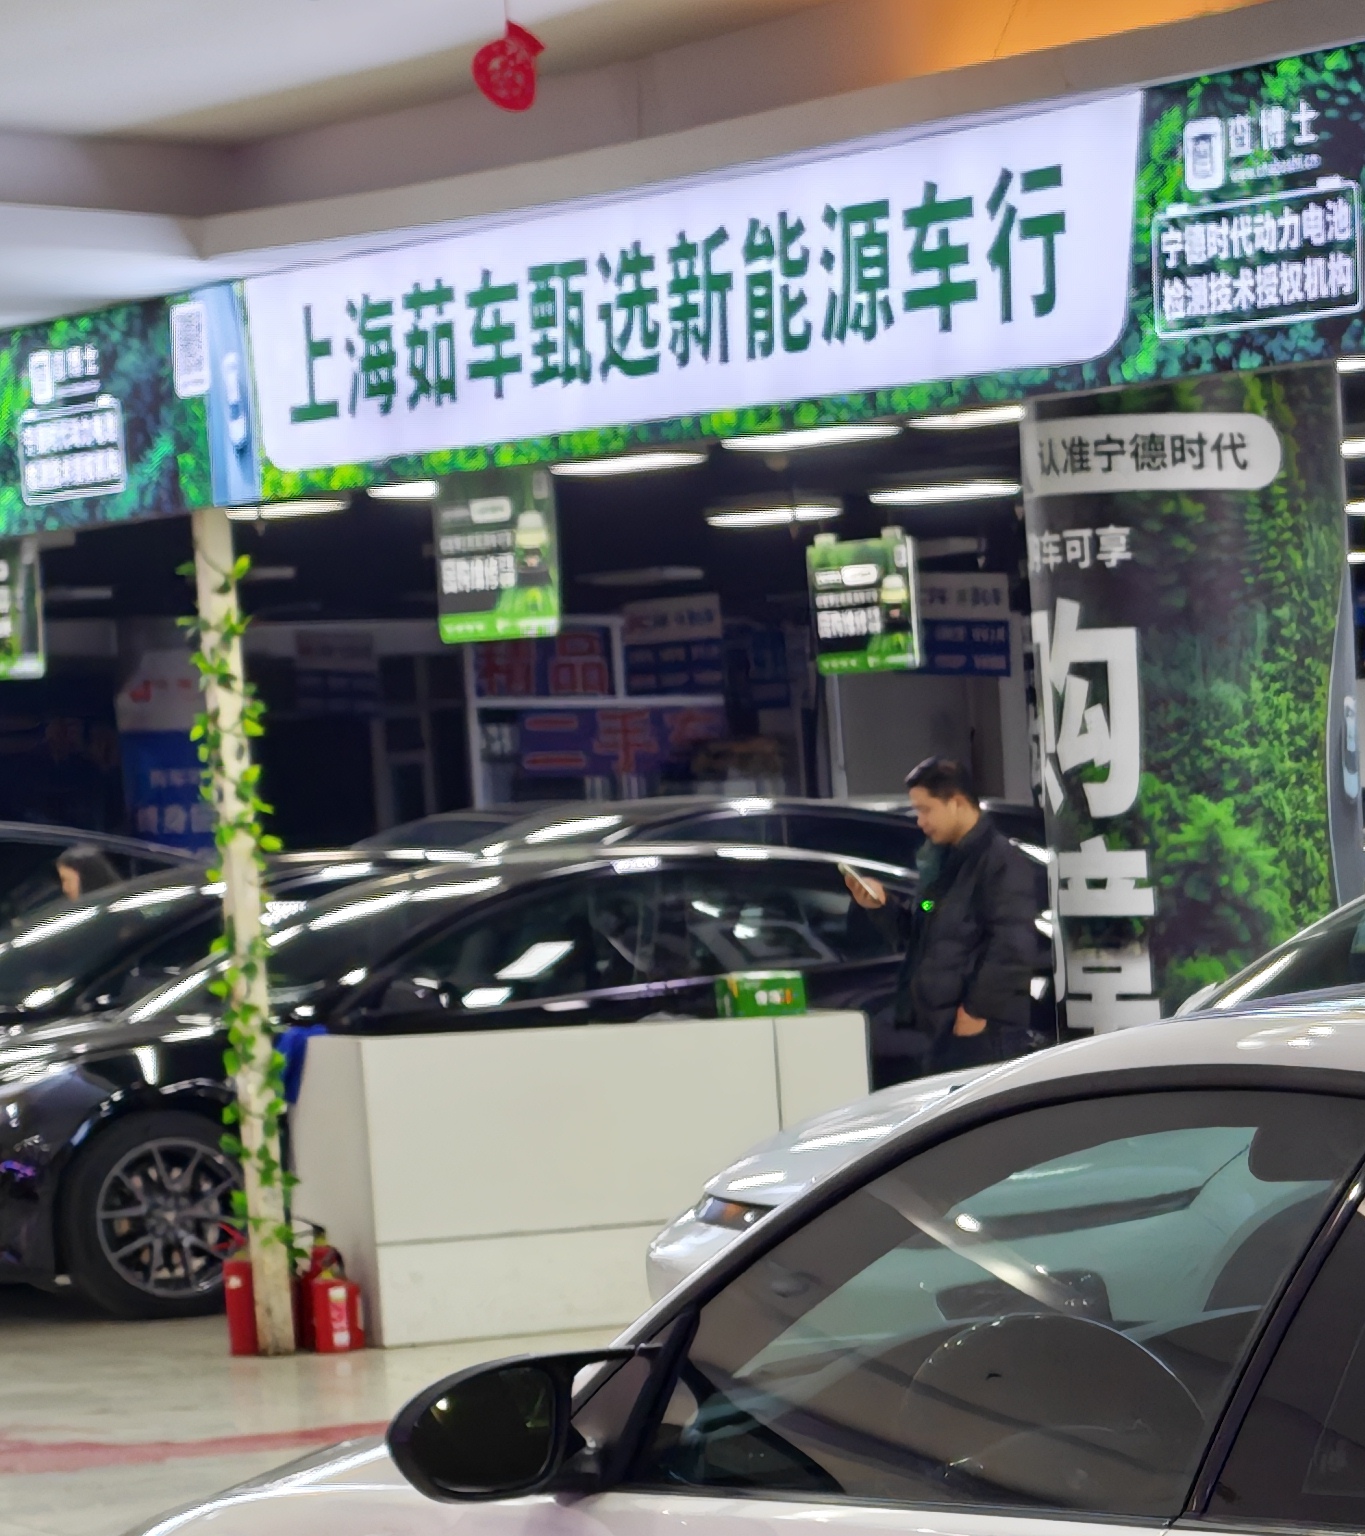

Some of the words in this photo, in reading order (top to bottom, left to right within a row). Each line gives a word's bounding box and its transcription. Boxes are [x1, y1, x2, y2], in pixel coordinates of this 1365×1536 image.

[289, 163, 1067, 425] 上海茹车甄选新能源车行
[1037, 431, 1249, 477] 认准宁德时代
